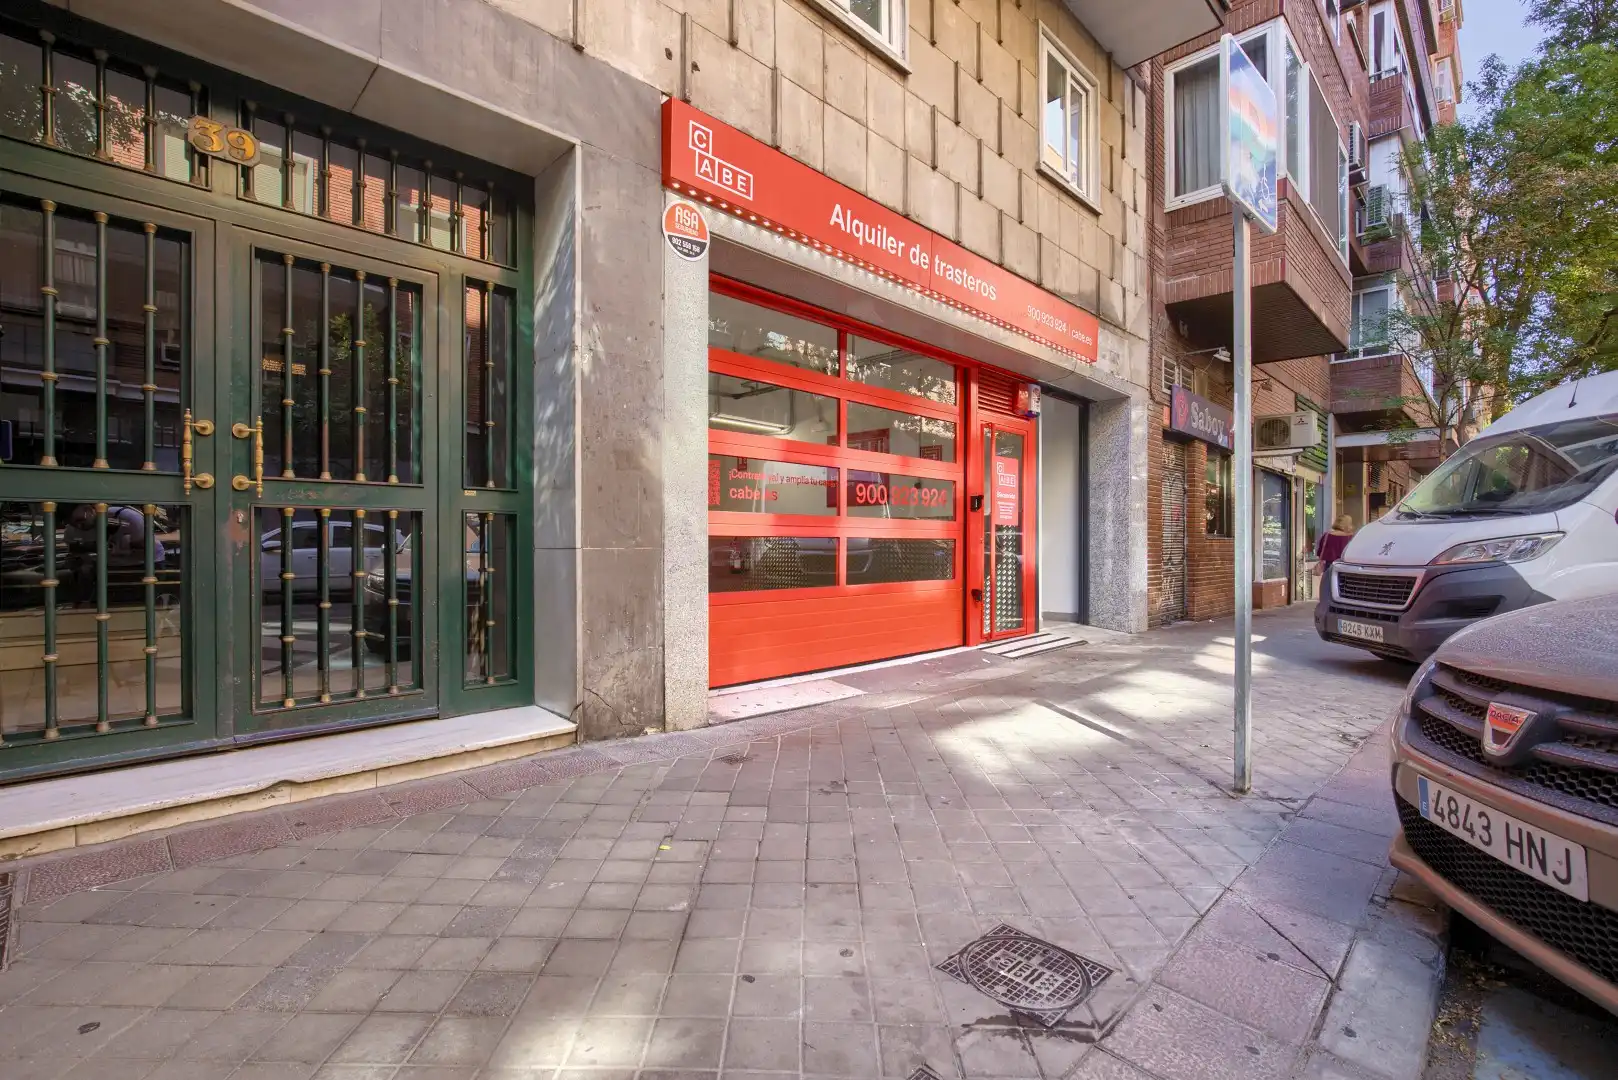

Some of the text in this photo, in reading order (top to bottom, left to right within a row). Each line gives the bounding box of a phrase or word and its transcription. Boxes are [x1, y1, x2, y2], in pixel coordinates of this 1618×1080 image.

[193, 119, 256, 162] 39
[693, 129, 748, 193] CABE
[675, 205, 699, 231] ASA
[829, 203, 997, 301] Alquiler de trasteros
[1027, 305, 1041, 321] 900
[1041, 312, 1055, 328] 923
[1054, 318, 1068, 334] 924
[856, 483, 887, 504] 900
[1489, 710, 1519, 724] DACIA
[1433, 789, 1572, 885] 4843 HNJ
